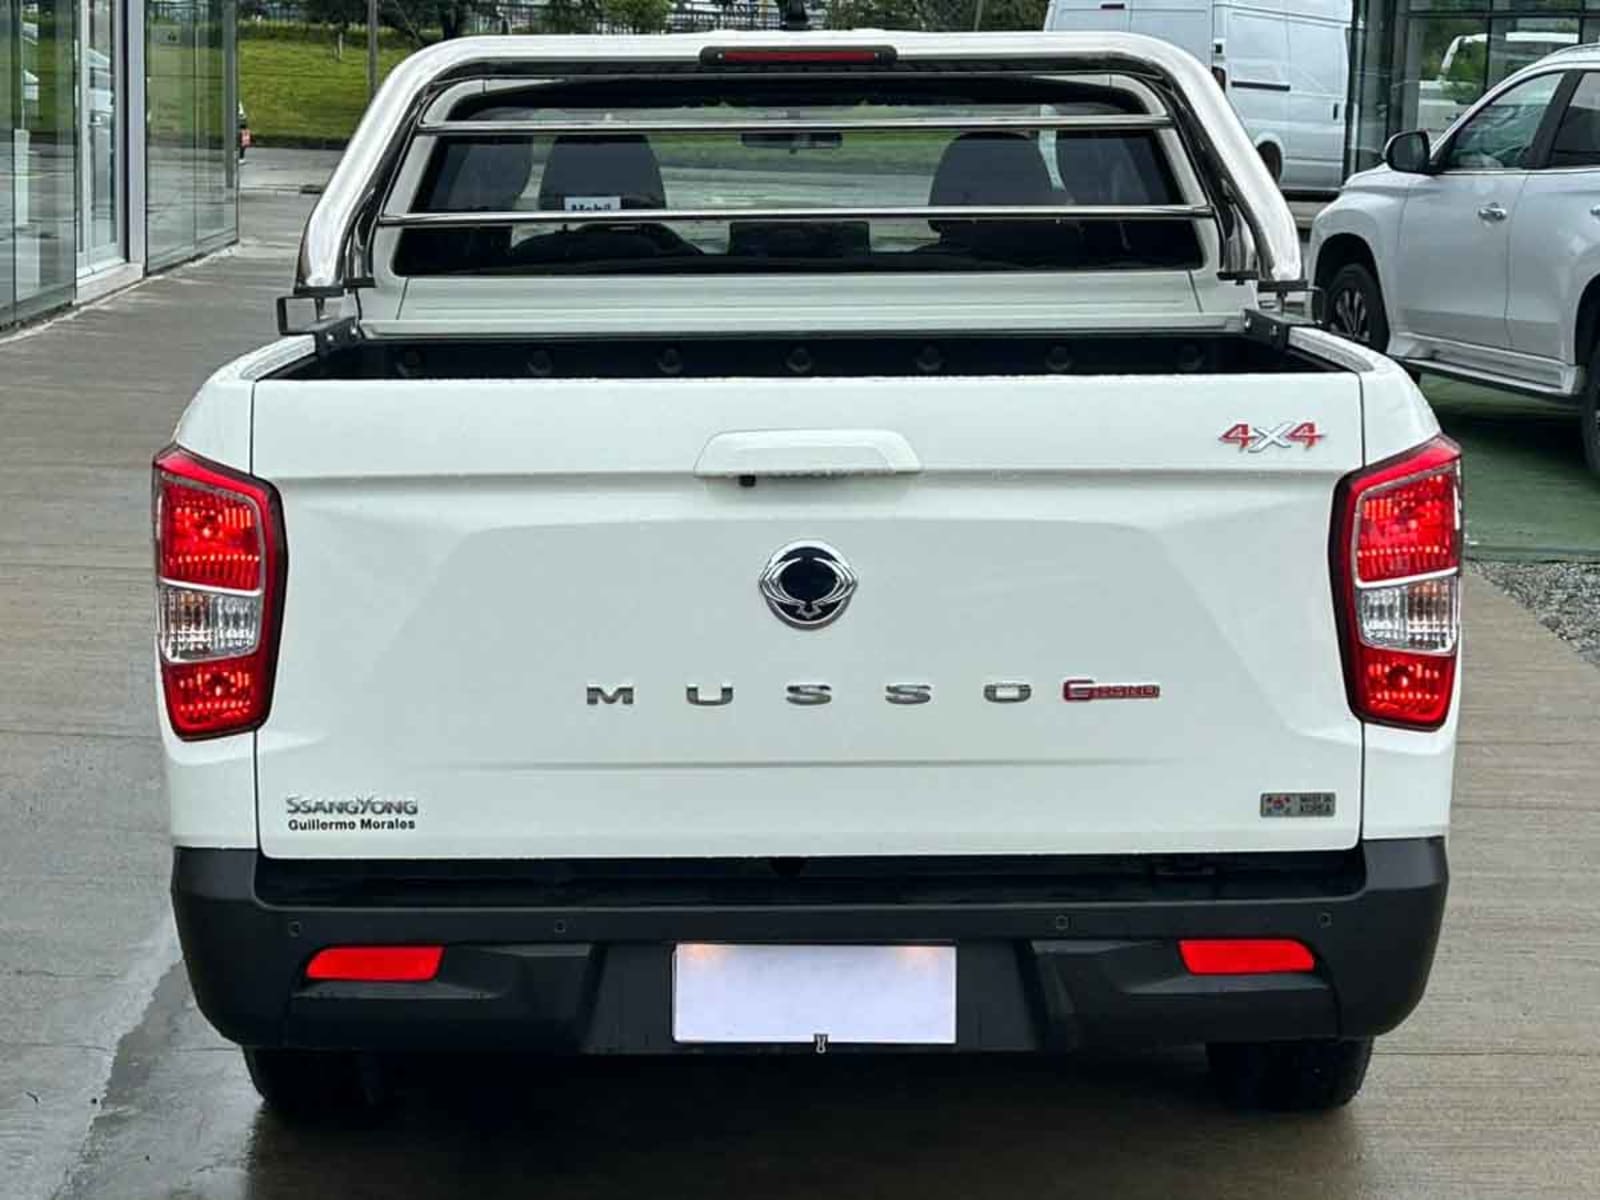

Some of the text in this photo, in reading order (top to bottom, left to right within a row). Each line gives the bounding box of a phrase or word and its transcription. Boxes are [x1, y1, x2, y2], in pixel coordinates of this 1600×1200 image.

[586, 684, 1031, 706] MUSSO
[288, 817, 415, 831] Guillermo Morales
